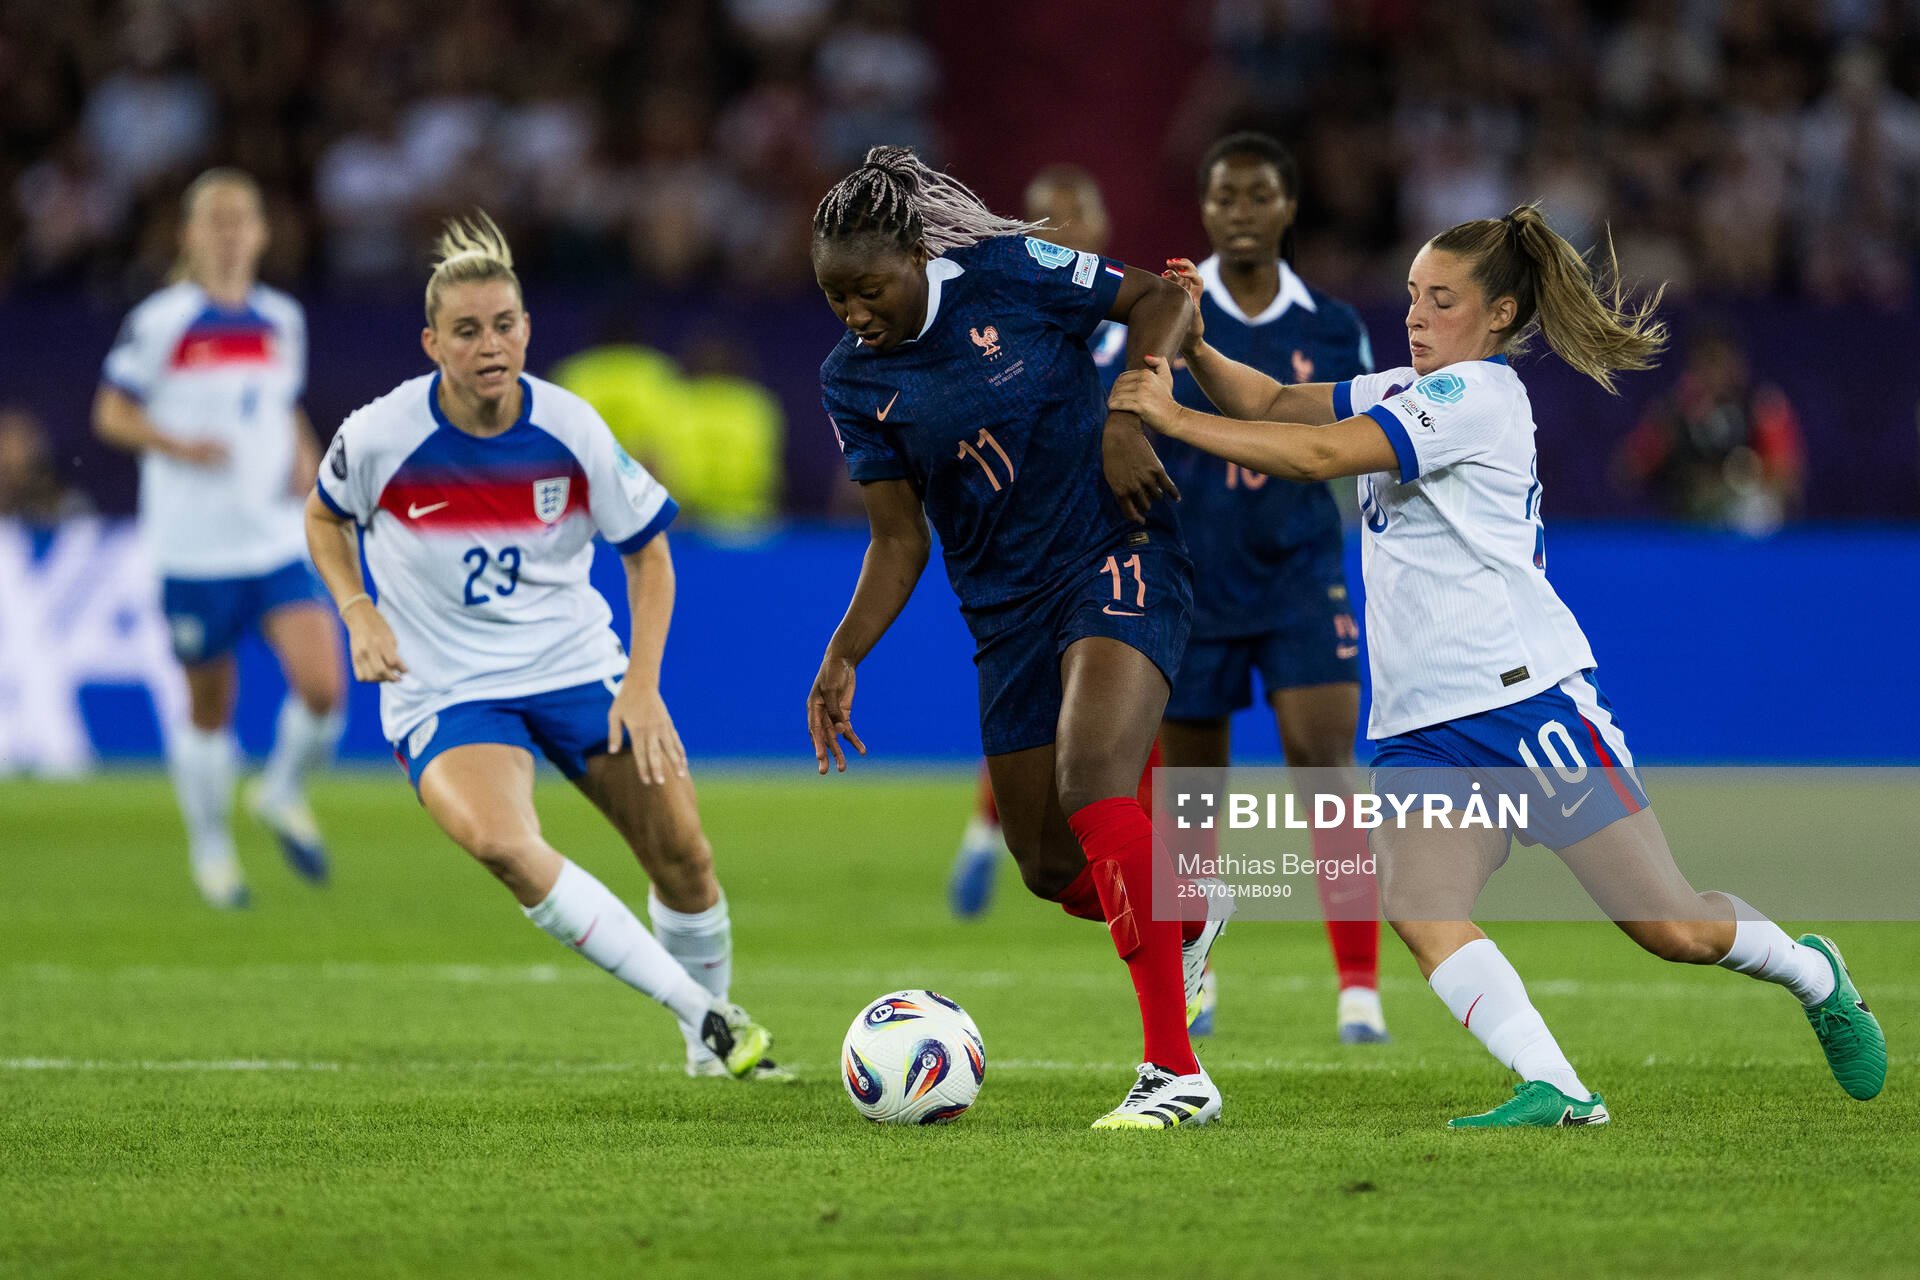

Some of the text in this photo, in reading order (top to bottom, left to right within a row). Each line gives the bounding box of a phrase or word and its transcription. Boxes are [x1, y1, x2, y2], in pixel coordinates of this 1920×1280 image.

[957, 428, 1015, 492] 11
[463, 546, 521, 607] 23
[1100, 554, 1146, 608] 11
[1518, 719, 1588, 799] 10
